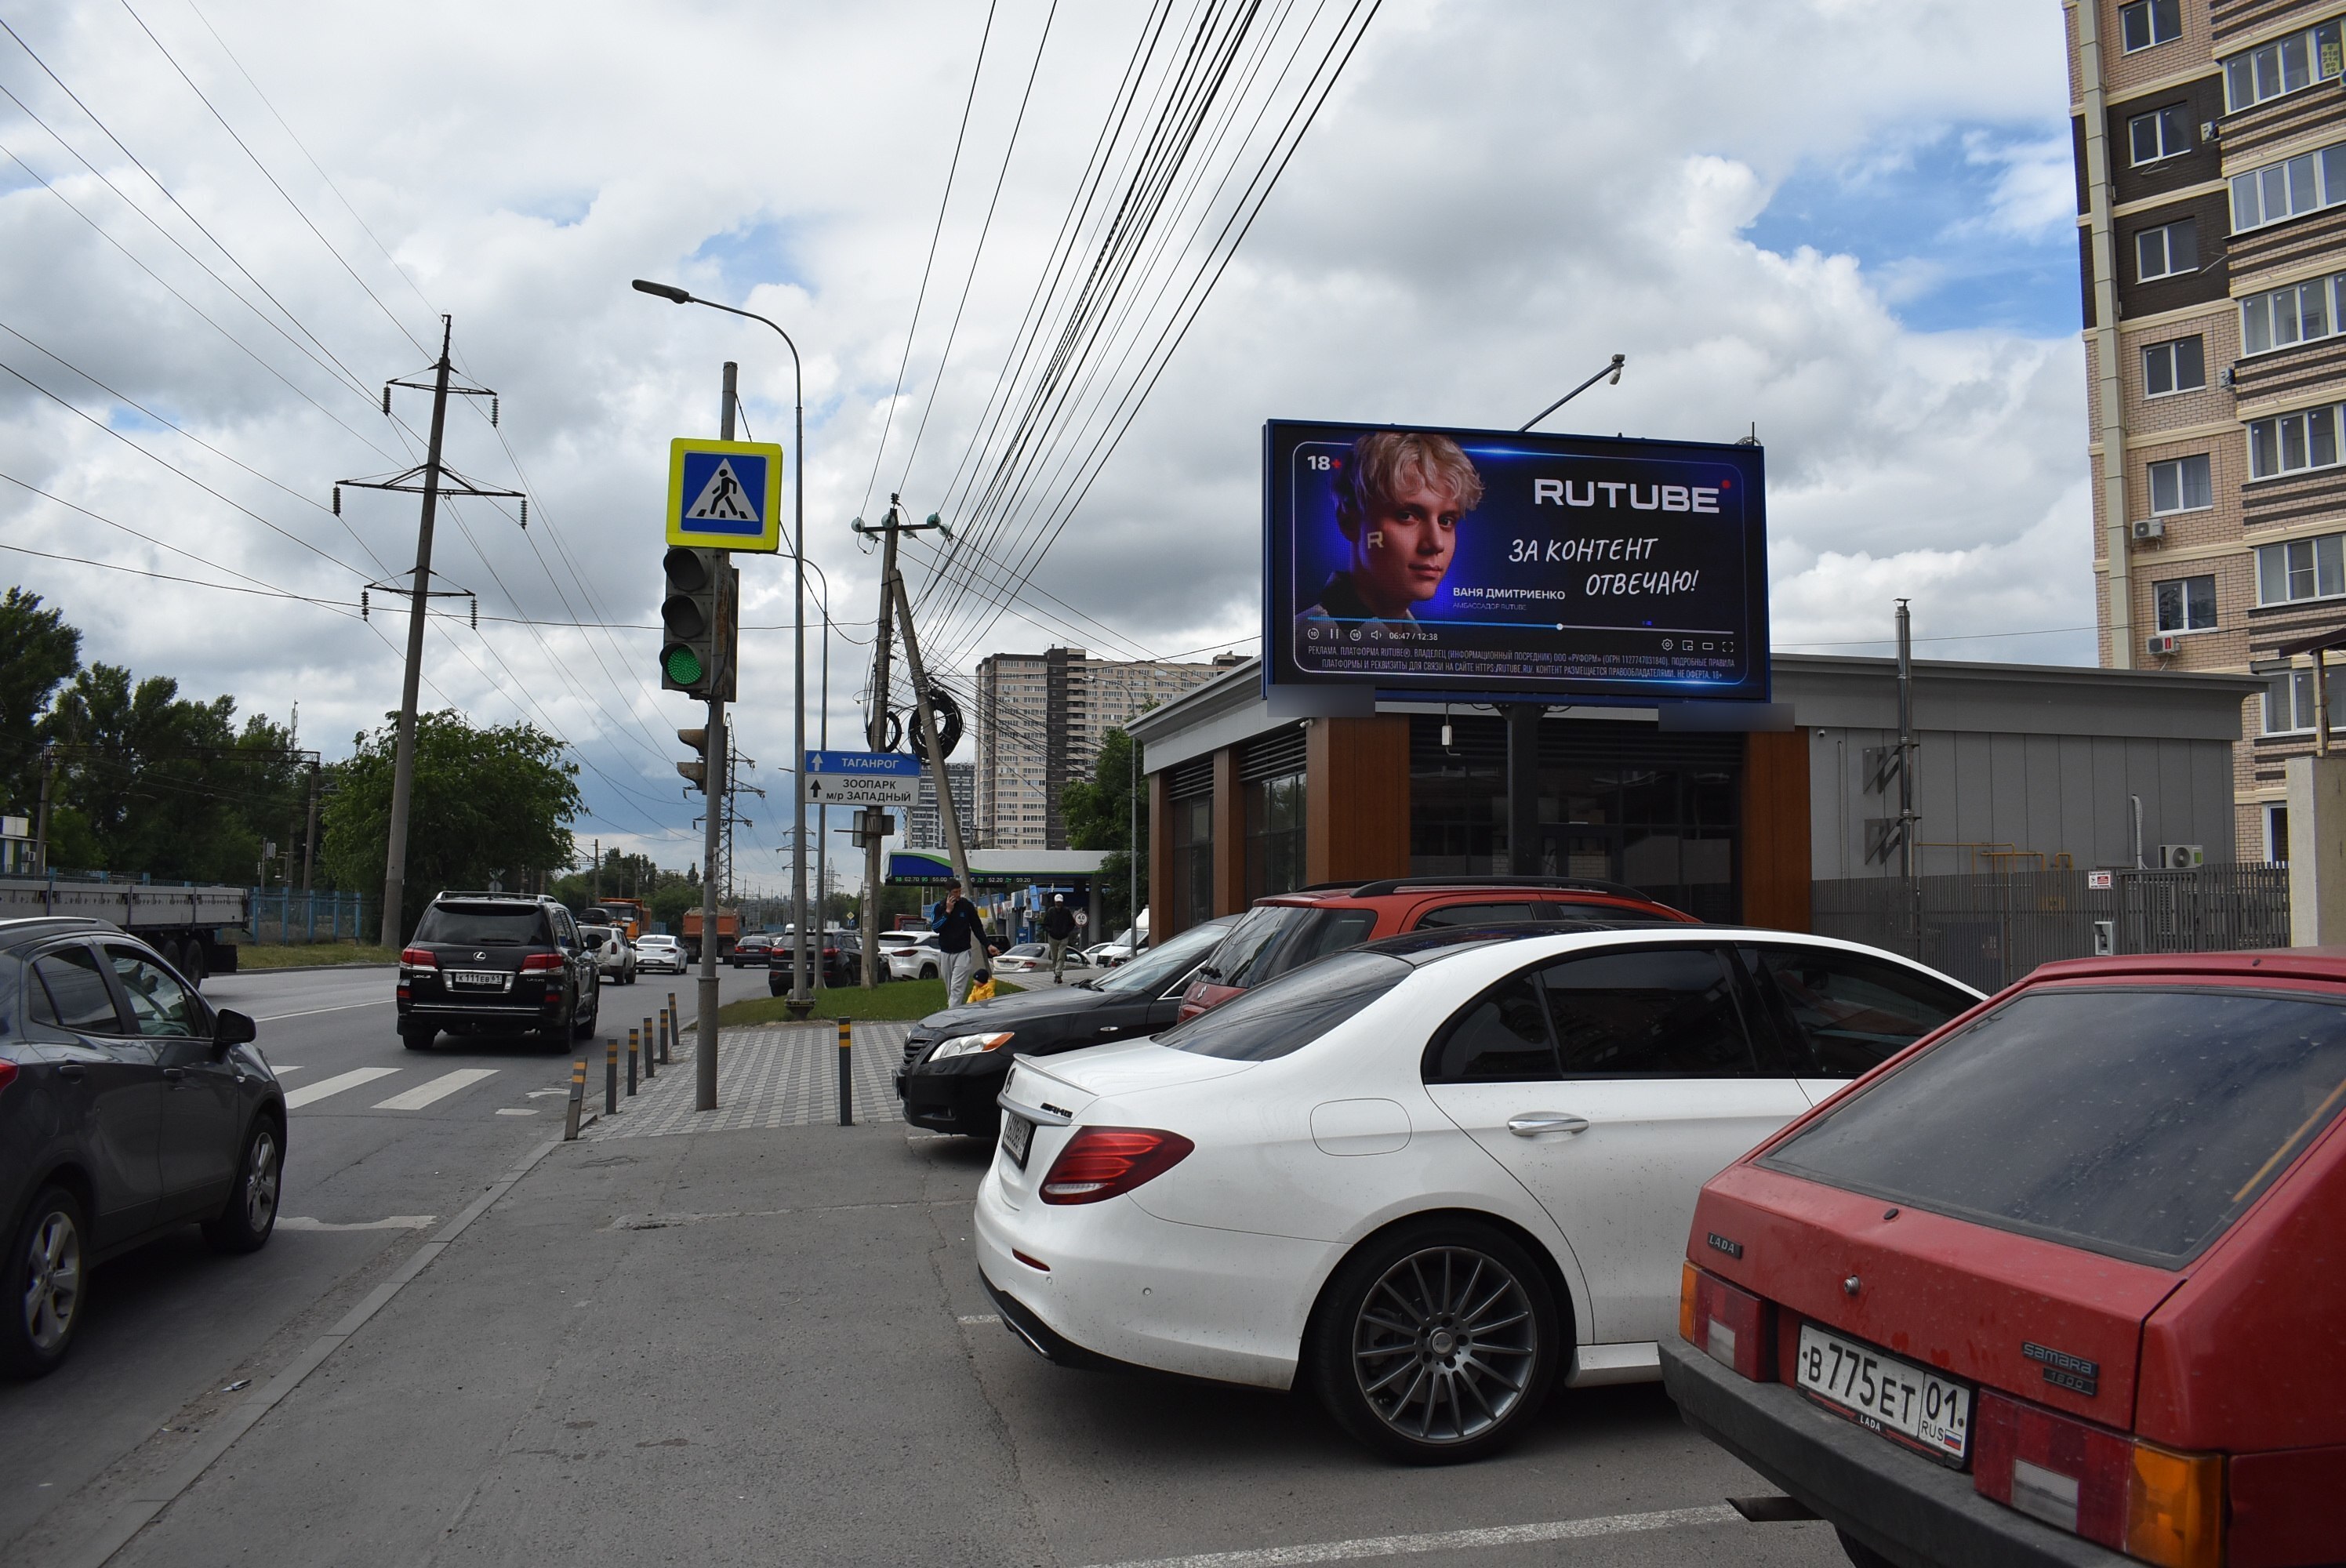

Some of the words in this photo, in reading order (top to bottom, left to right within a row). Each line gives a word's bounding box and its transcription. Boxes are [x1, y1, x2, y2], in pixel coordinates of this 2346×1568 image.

[1307, 456, 1342, 470] 18+
[1534, 478, 1720, 514] RUTUBE
[1367, 531, 1384, 549] R
[1509, 539, 1538, 562] ЗА
[1545, 538, 1659, 562] КОНТЕНТ
[1585, 570, 1699, 596] ОТВЕЧАЮ!
[1453, 587, 1484, 597] ВАНЯ
[1486, 588, 1566, 600] ДМИТРИЕНКО
[1309, 646, 1338, 655] РЕКЛАМА.
[1341, 647, 1379, 656] ПЛАТФОРМА
[1414, 649, 1446, 659] ВЛАДЕЛЕЦ
[1448, 650, 1513, 660] (ИНФОРМАЦИОННЫЙ
[1514, 652, 1552, 662] ПОСРЕДНИК)
[1568, 654, 1601, 662] «РУФОРМ»
[1603, 655, 1620, 665] (ОГРН
[1672, 657, 1706, 666] ПОДРОБНЫЕ
[1709, 659, 1734, 667] ПРАВИЛА
[1322, 659, 1362, 668] ПЛАТФОРМЫ
[1364, 660, 1368, 669] И
[1371, 661, 1407, 670] РЕКВИЗИТЫ
[1409, 662, 1422, 671] ДЛЯ
[1423, 662, 1443, 670] СВЯЗИ
[1445, 662, 1454, 671] НА
[1455, 662, 1473, 672] САЙТЕ
[1537, 665, 1562, 674] КОНТЕНТ
[1564, 666, 1607, 676] РАЗМЕЩАЕТСЯ
[1609, 667, 1675, 677] ПРАВООБЛАДАТЕЛЯМИ.
[1677, 670, 1685, 678] НЕ
[1687, 670, 1710, 679] ОФЕРТА.
[1712, 670, 1722, 679] 18+
[841, 758, 899, 769] ТАГАНРОГ
[843, 779, 896, 789] ЗООПАРК
[826, 792, 844, 801] м/р
[847, 791, 911, 802] ЗАПАДНЫЙ
[1709, 1235, 1734, 1254] LADA
[1927, 1381, 1958, 1428] 01
[1860, 1414, 1881, 1432] LADA
[1922, 1420, 1945, 1441] RUS
